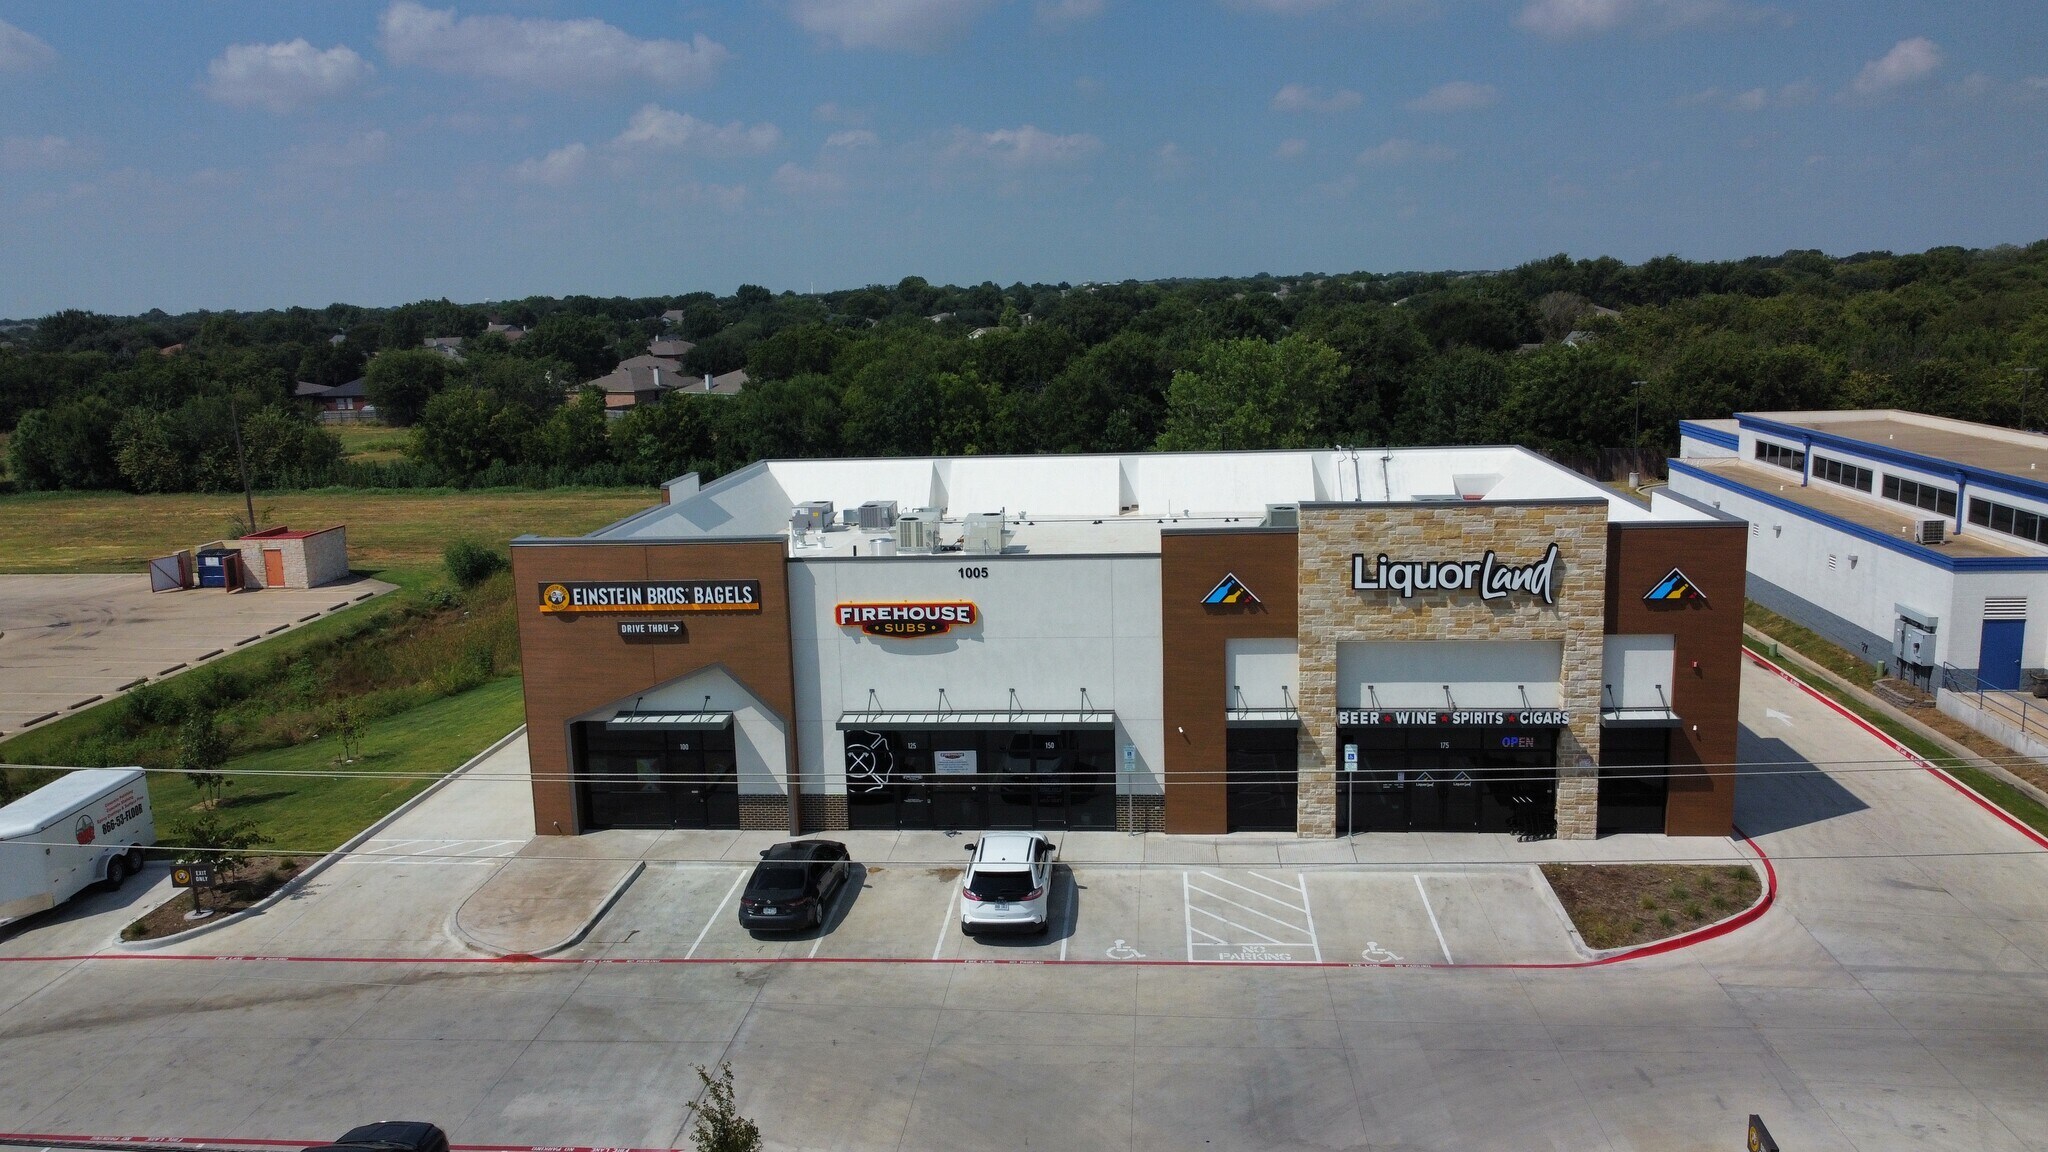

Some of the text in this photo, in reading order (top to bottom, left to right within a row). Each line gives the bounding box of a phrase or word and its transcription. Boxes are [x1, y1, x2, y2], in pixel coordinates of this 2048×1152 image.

[958, 567, 989, 579] 1005
[573, 587, 642, 605] EINSTEIN
[693, 586, 753, 604] BAGELS
[840, 606, 970, 624] FIREHOUSE
[621, 624, 669, 633] DRIVE THRU
[884, 623, 926, 632] SUBS
[1339, 711, 1570, 725] BEER WINE SPIRITS CIGARS
[1440, 741, 1450, 749] 175
[1501, 737, 1534, 748] OPEN
[101, 803, 144, 835] 866-53-FLOOR
[1241, 945, 1266, 953] NO
[1218, 952, 1292, 961] PARKING
